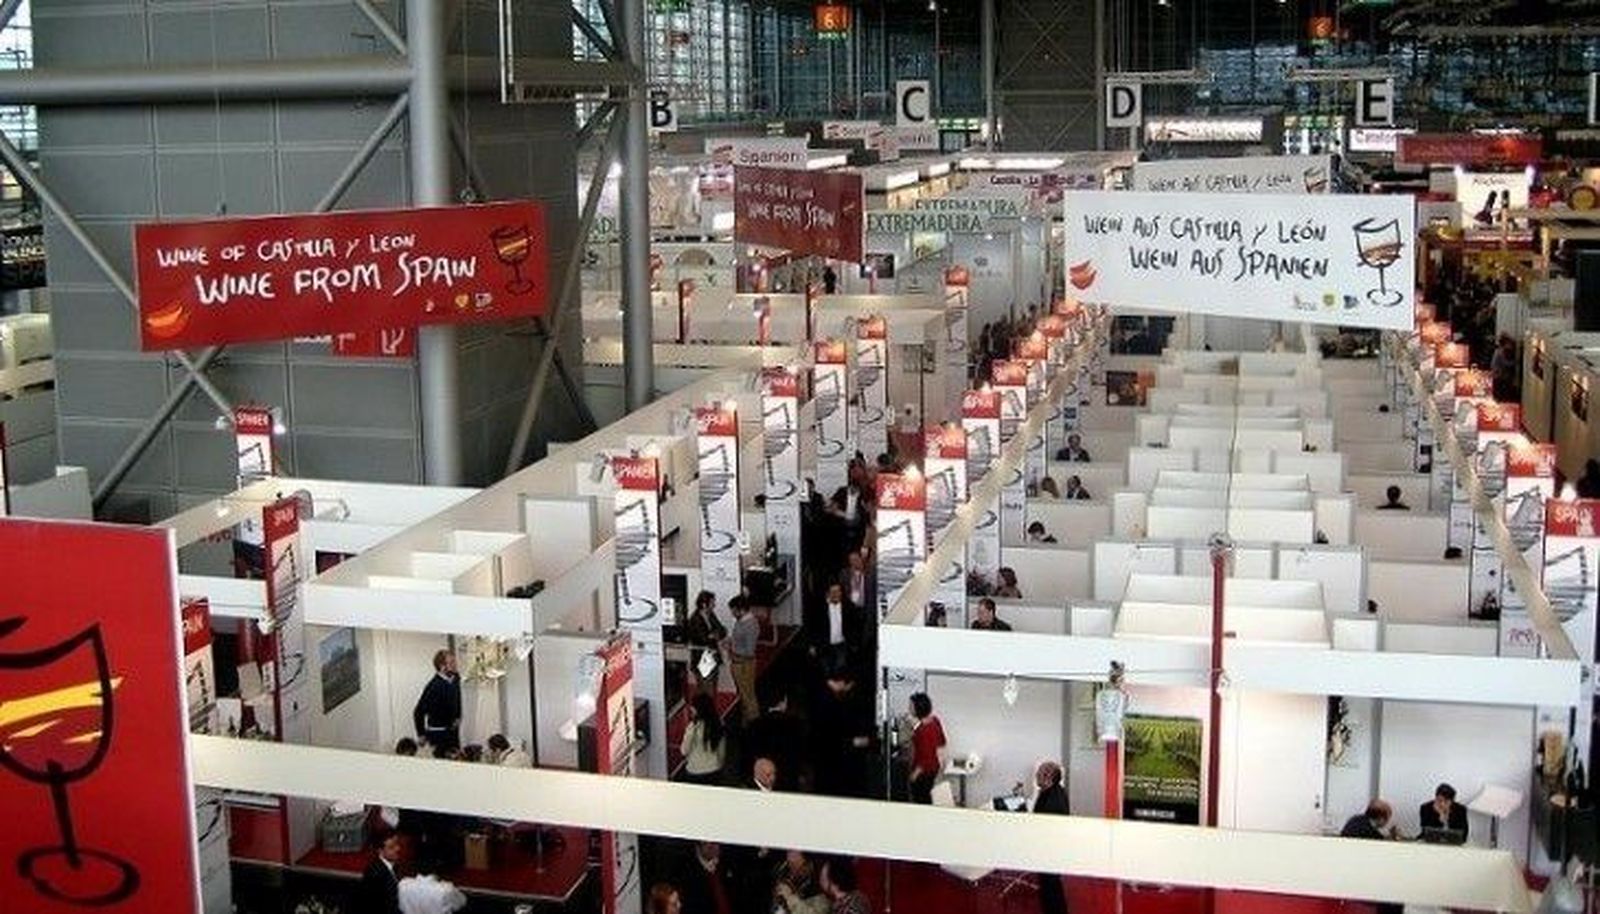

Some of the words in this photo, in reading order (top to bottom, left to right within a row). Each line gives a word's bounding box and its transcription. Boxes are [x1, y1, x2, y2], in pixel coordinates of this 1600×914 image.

[650, 91, 673, 127] B
[902, 86, 925, 122] C
[1112, 86, 1136, 119] D
[1362, 80, 1391, 121] E
[867, 213, 983, 233] EXTREMADURA
[1084, 214, 1122, 235] WEIN
[1133, 215, 1161, 239] AUS
[1170, 214, 1243, 242] CASTILLA
[1278, 218, 1327, 244] LEÓN
[156, 247, 209, 268] WINE
[220, 244, 246, 261] OF
[257, 237, 337, 262] CASTILLA
[1129, 246, 1178, 270] WEIN
[1190, 248, 1225, 279] AUS
[1233, 245, 1330, 281] SPANIEN
[194, 272, 276, 305] WINE
[294, 261, 382, 303] FROM
[393, 251, 477, 297] SPAIN
